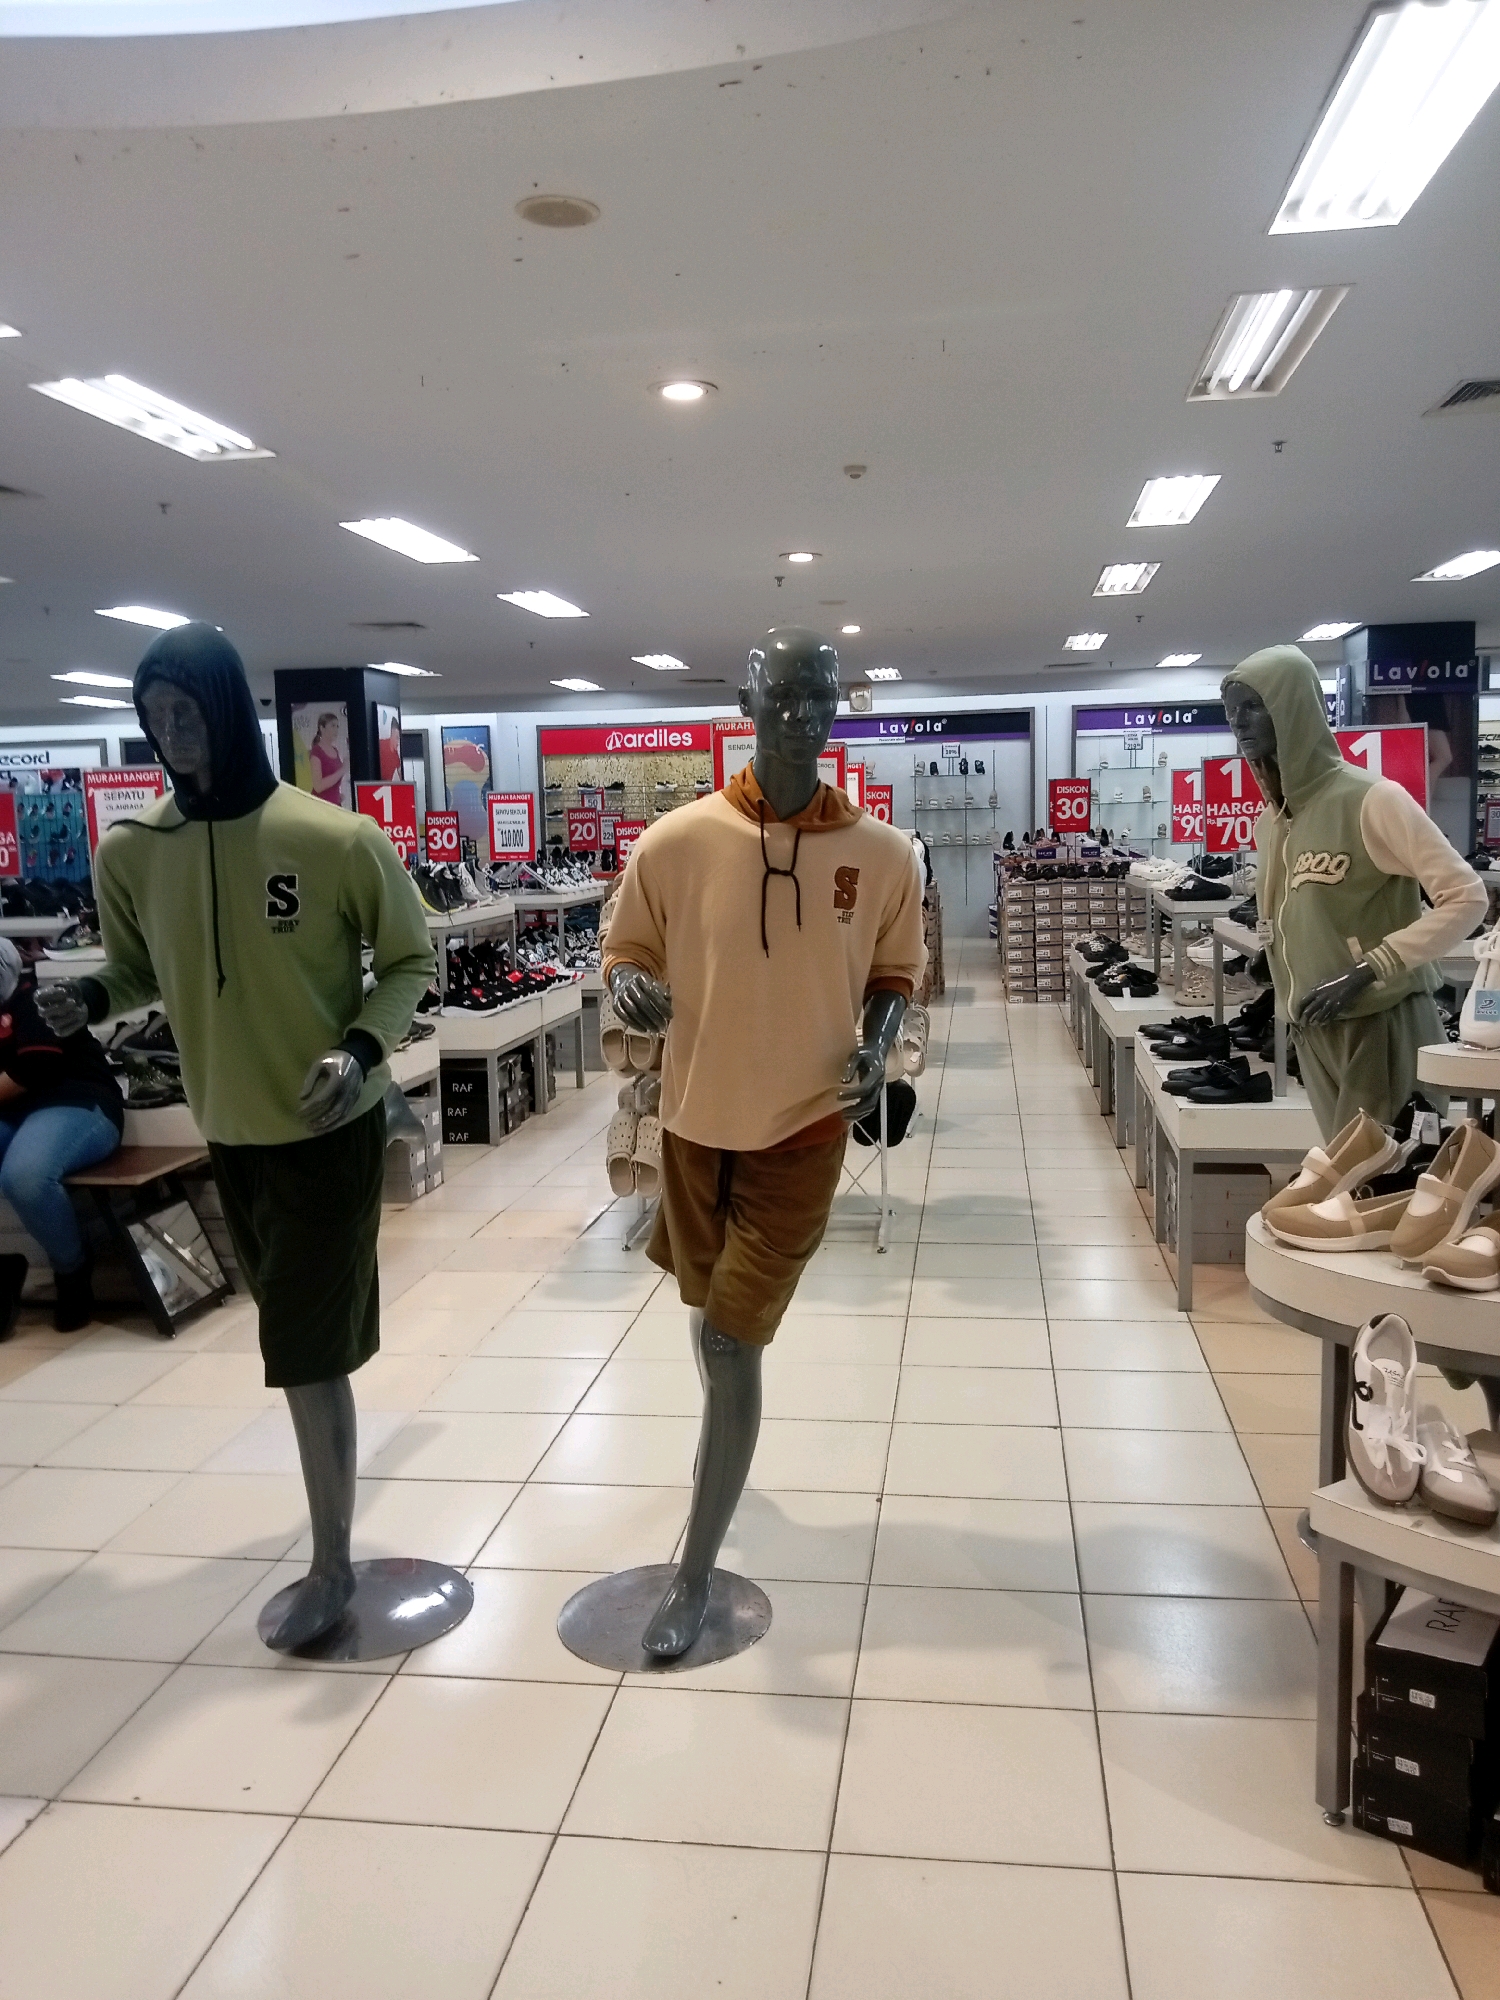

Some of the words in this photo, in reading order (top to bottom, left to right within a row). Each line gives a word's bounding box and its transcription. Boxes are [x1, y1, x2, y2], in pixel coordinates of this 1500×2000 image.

[716, 722, 750, 731] MURAH
[1349, 732, 1383, 776] 1
[87, 773, 122, 784] MURAH
[123, 771, 160, 782] BANGET
[1220, 758, 1242, 797] 1
[1056, 786, 1088, 794] DISKON
[1184, 771, 1201, 801] 1
[104, 790, 145, 801] SEPATU
[372, 786, 393, 823] 1
[1207, 801, 1266, 817] HARGA
[427, 816, 457, 826] DISKON
[569, 812, 596, 820] DISKON
[616, 826, 645, 836] DISKON
[501, 829, 523, 848] 110.000
[834, 866, 860, 911] S
[266, 874, 300, 919] S
[452, 1083, 473, 1093] RAF
[447, 1107, 468, 1117] RAF
[449, 1132, 469, 1142] RAF
